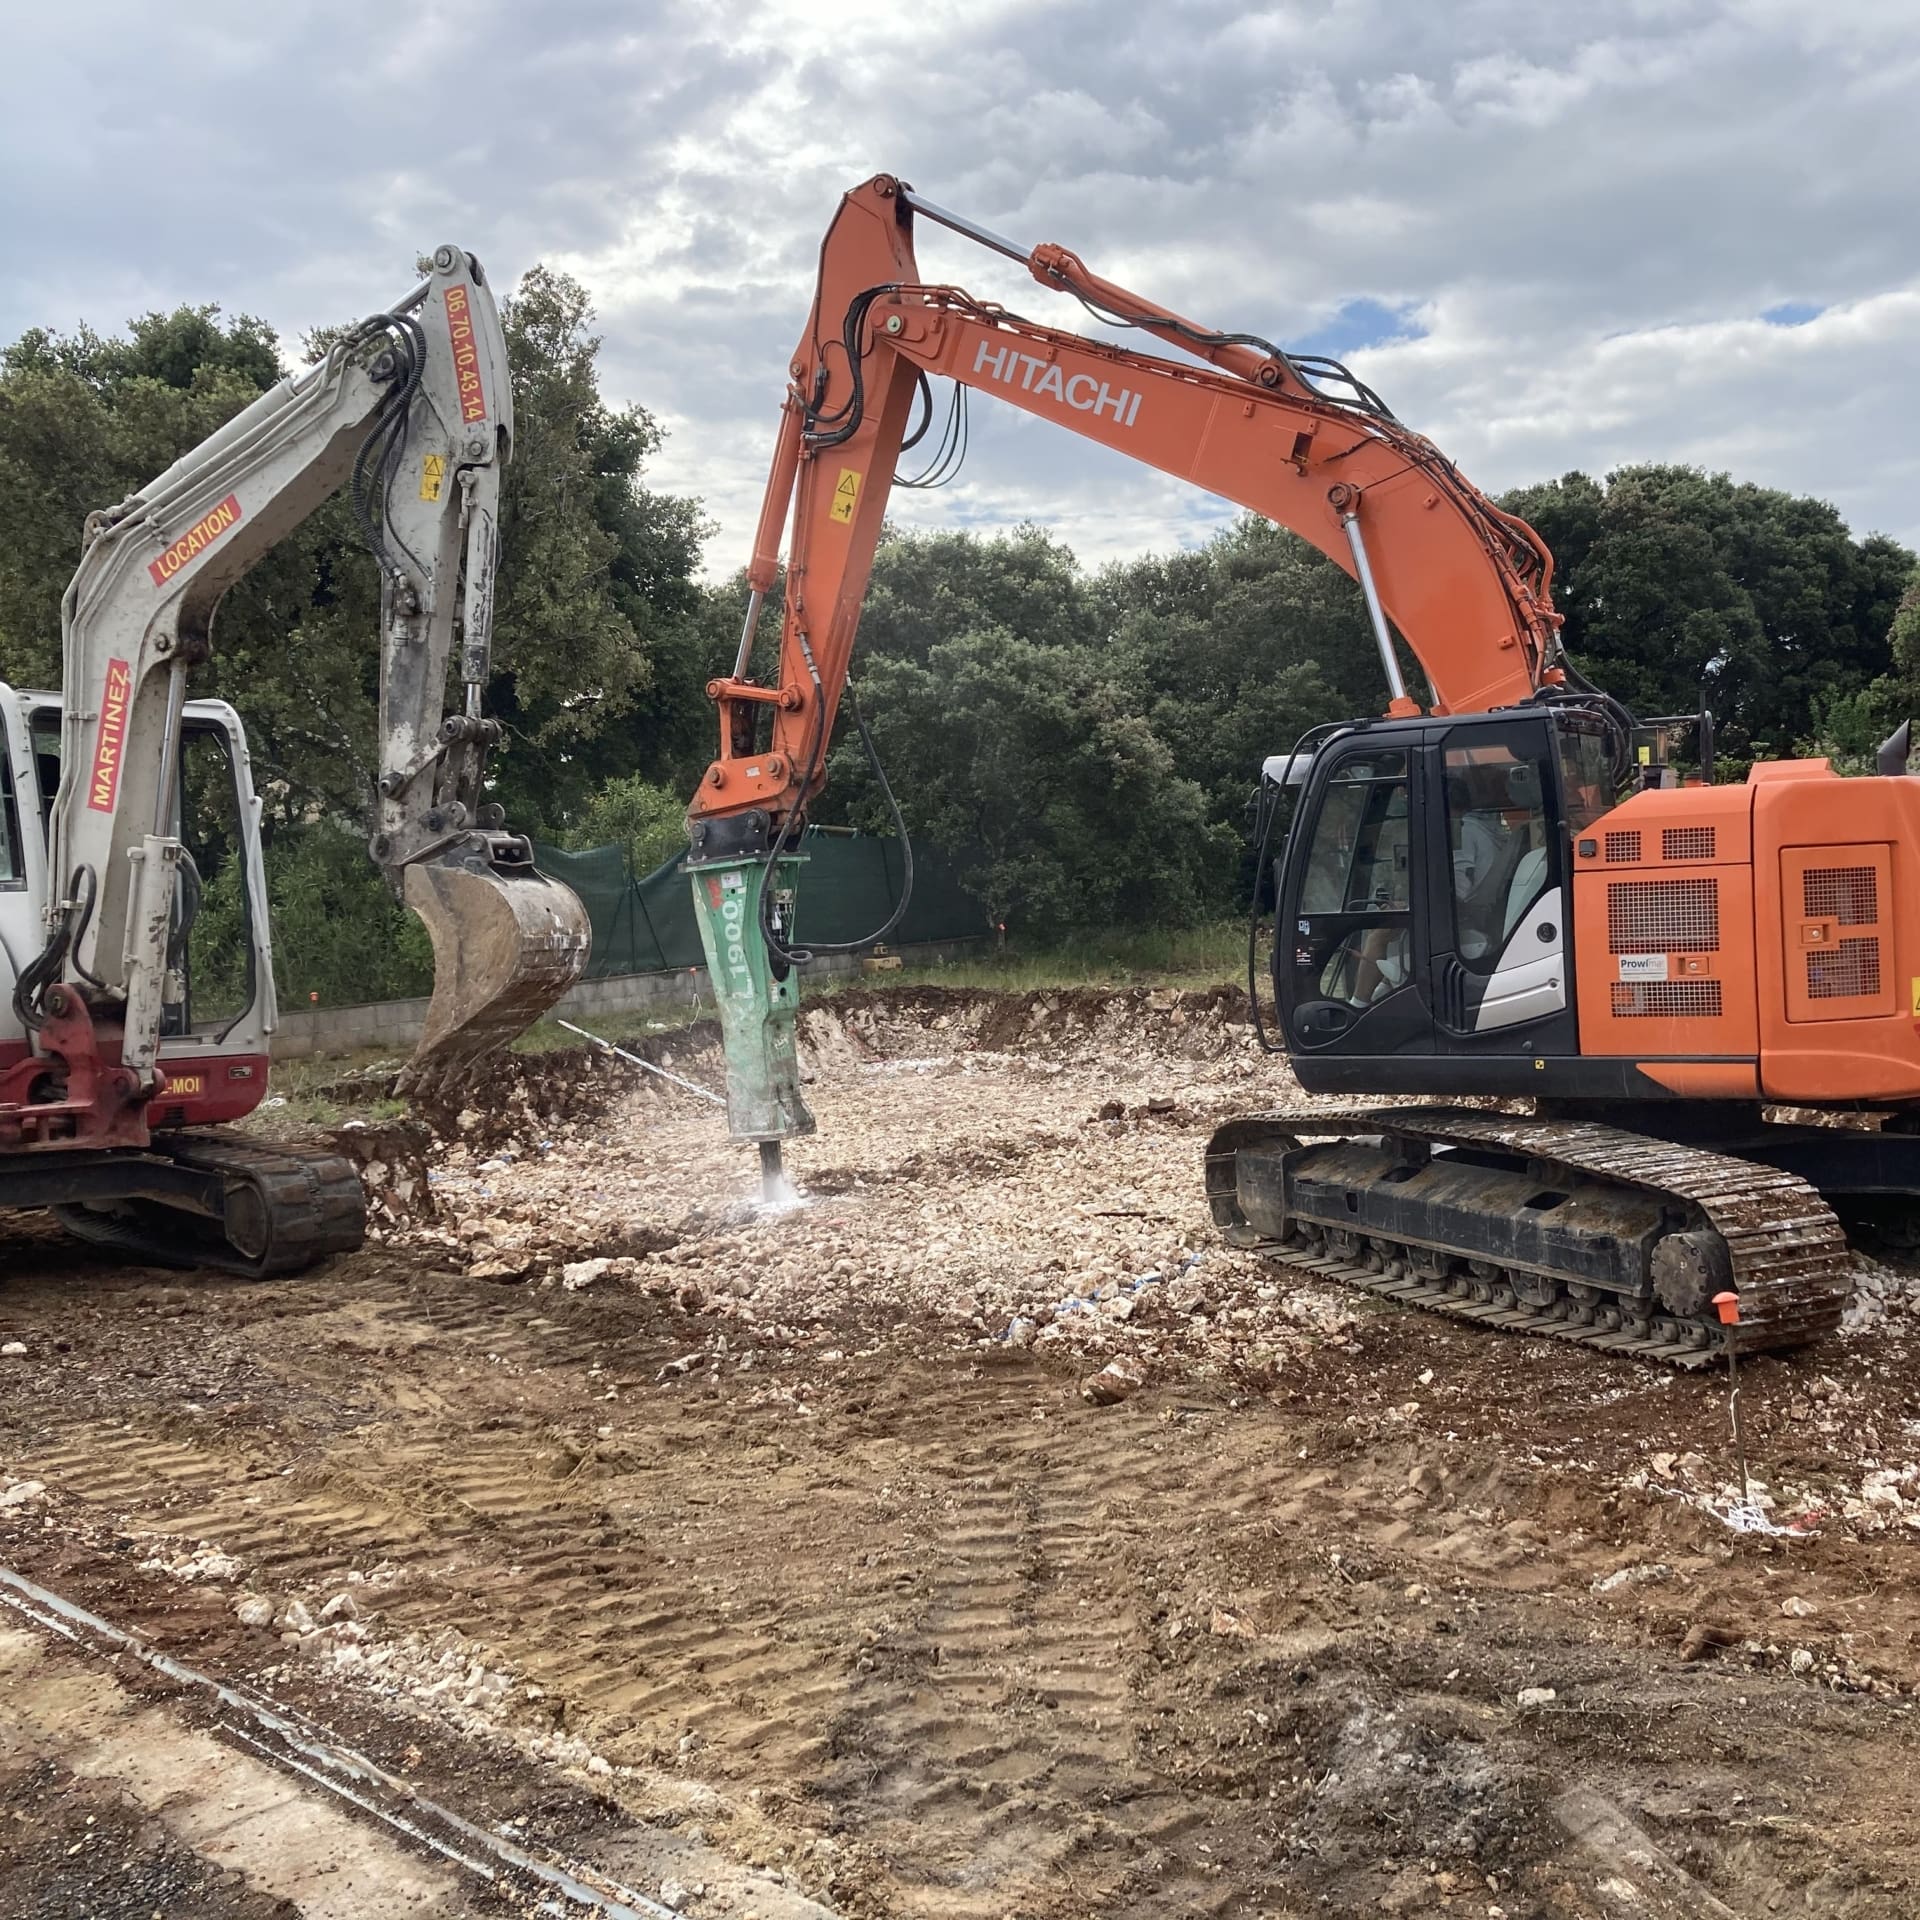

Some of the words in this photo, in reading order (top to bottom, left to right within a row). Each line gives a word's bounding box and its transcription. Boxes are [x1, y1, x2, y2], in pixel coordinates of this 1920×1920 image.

[447, 288, 483, 420] 06.70.10.43.14
[972, 340, 1143, 428] HITACHI
[156, 503, 233, 579] LOCATION
[93, 667, 128, 806] MARTINEZ
[160, 1077, 200, 1095] -MOI
